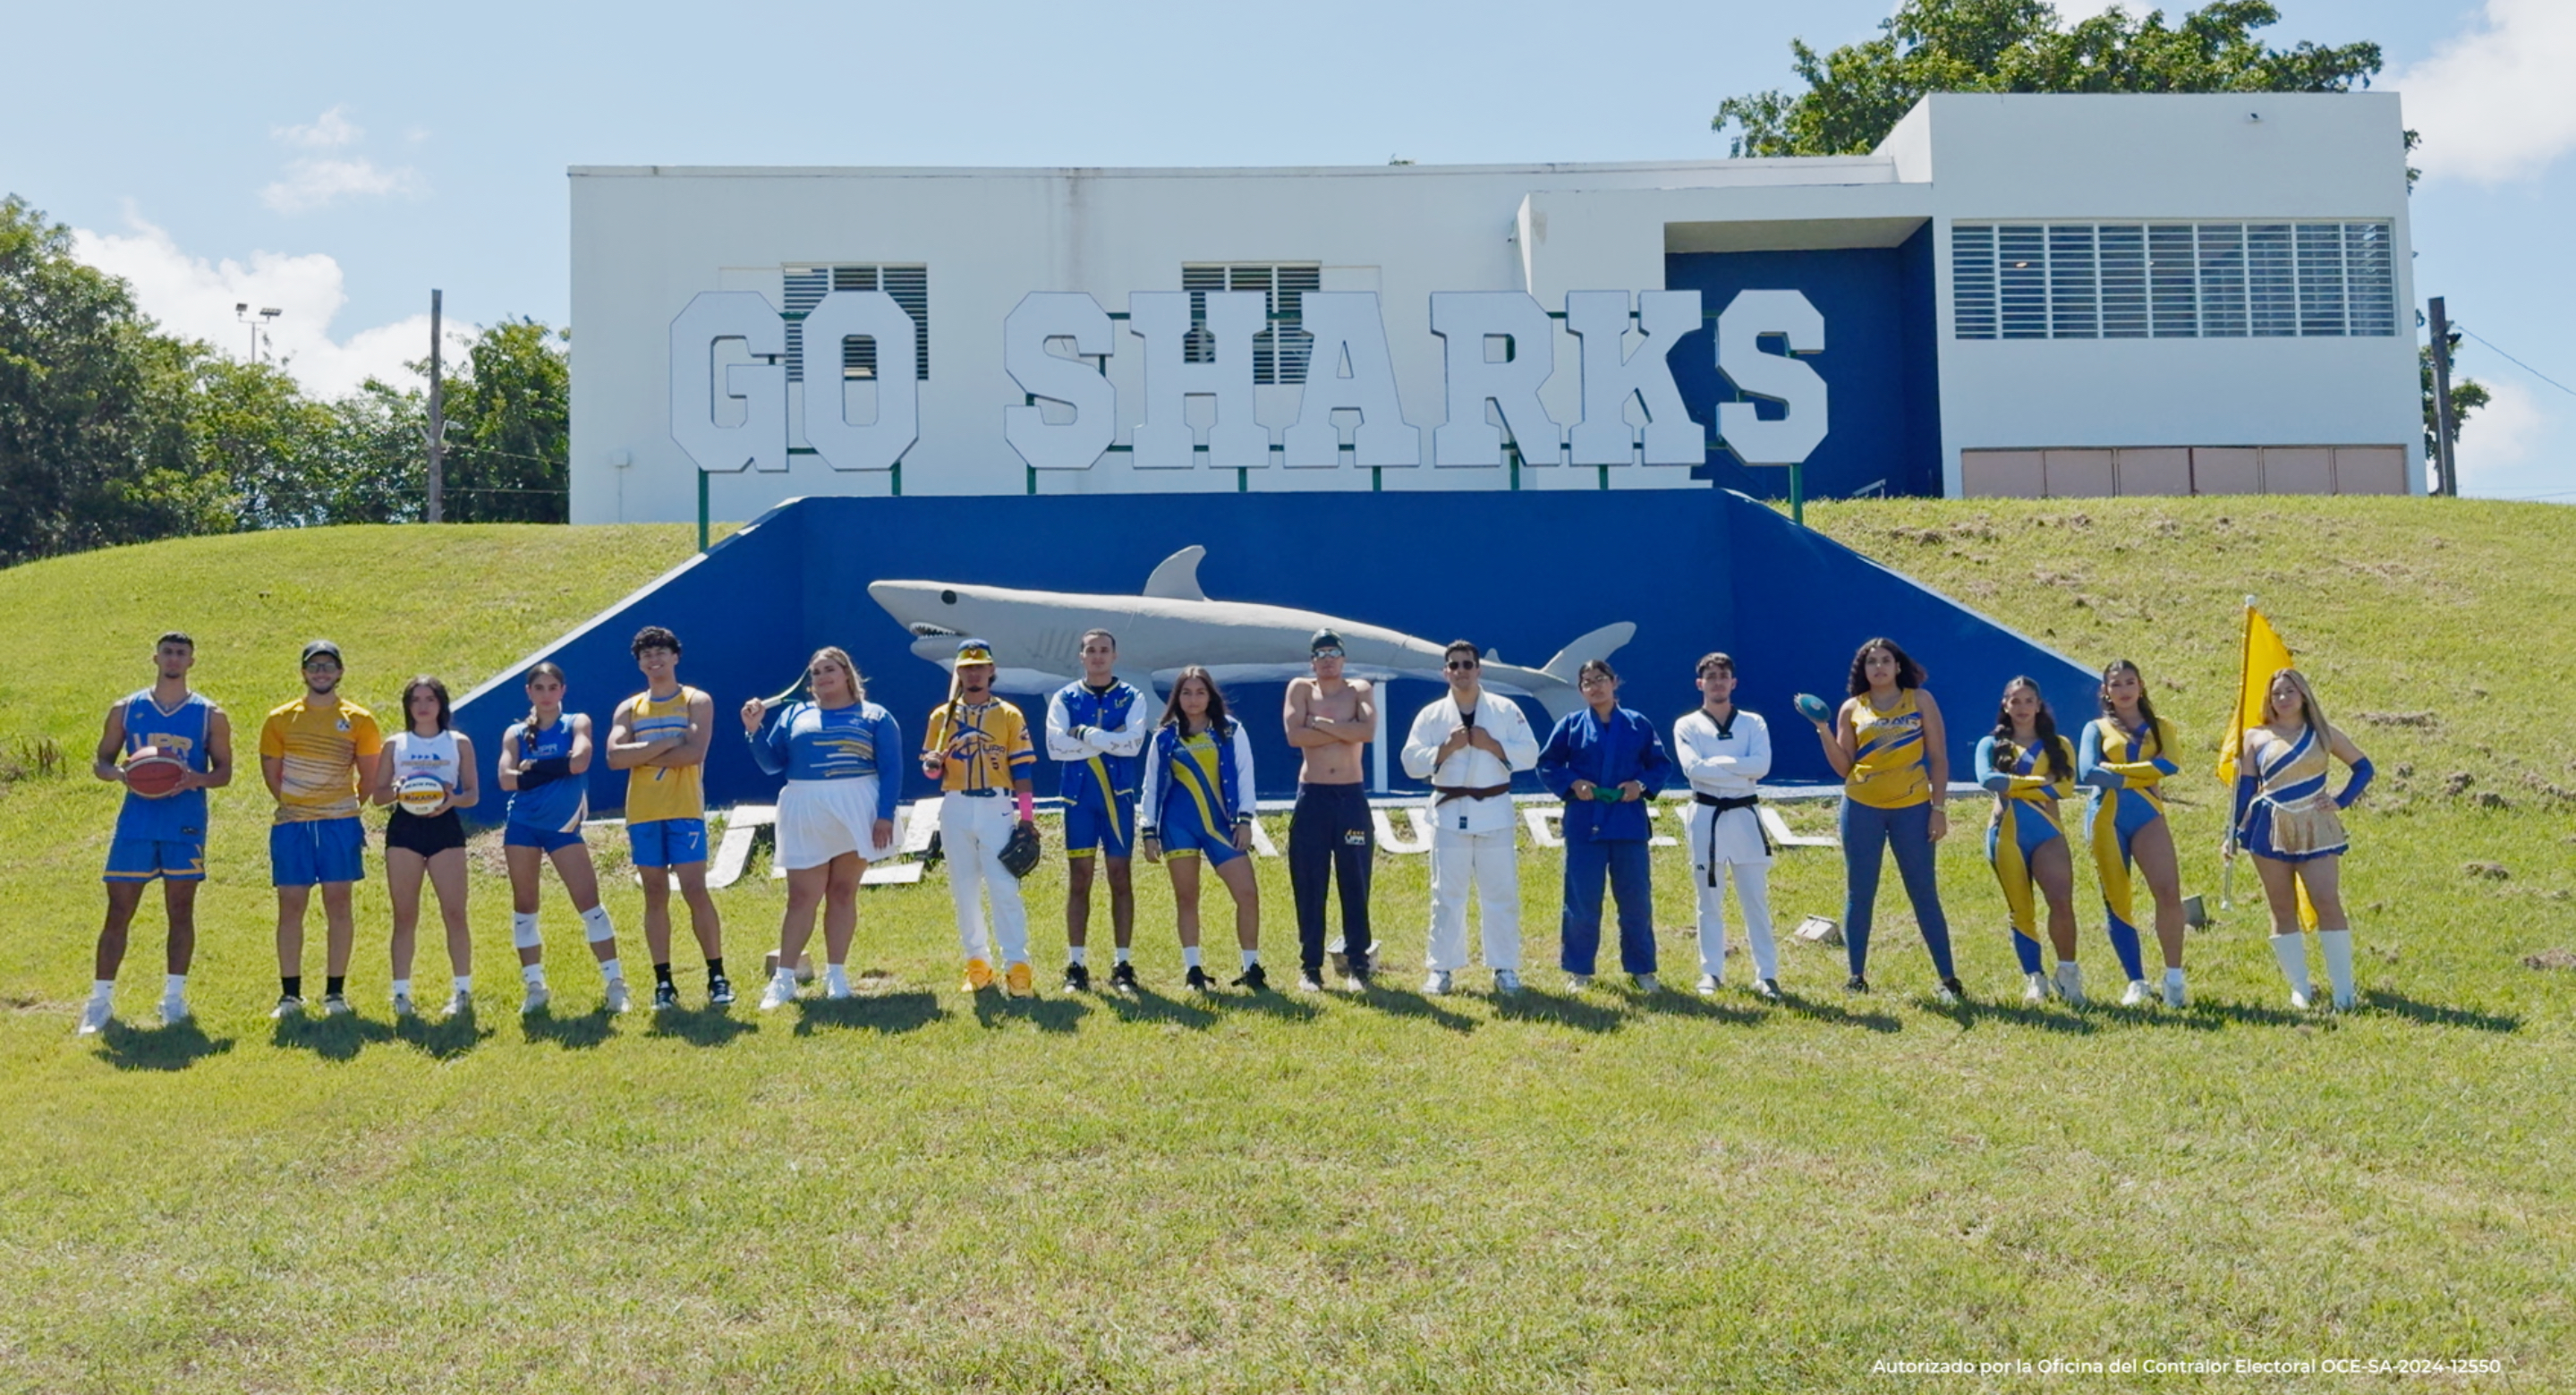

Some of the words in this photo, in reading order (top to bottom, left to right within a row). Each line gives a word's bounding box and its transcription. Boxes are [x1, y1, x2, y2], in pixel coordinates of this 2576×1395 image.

[669, 290, 920, 473] GO
[1003, 288, 1829, 472] SHARKS
[688, 831, 700, 850] 7
